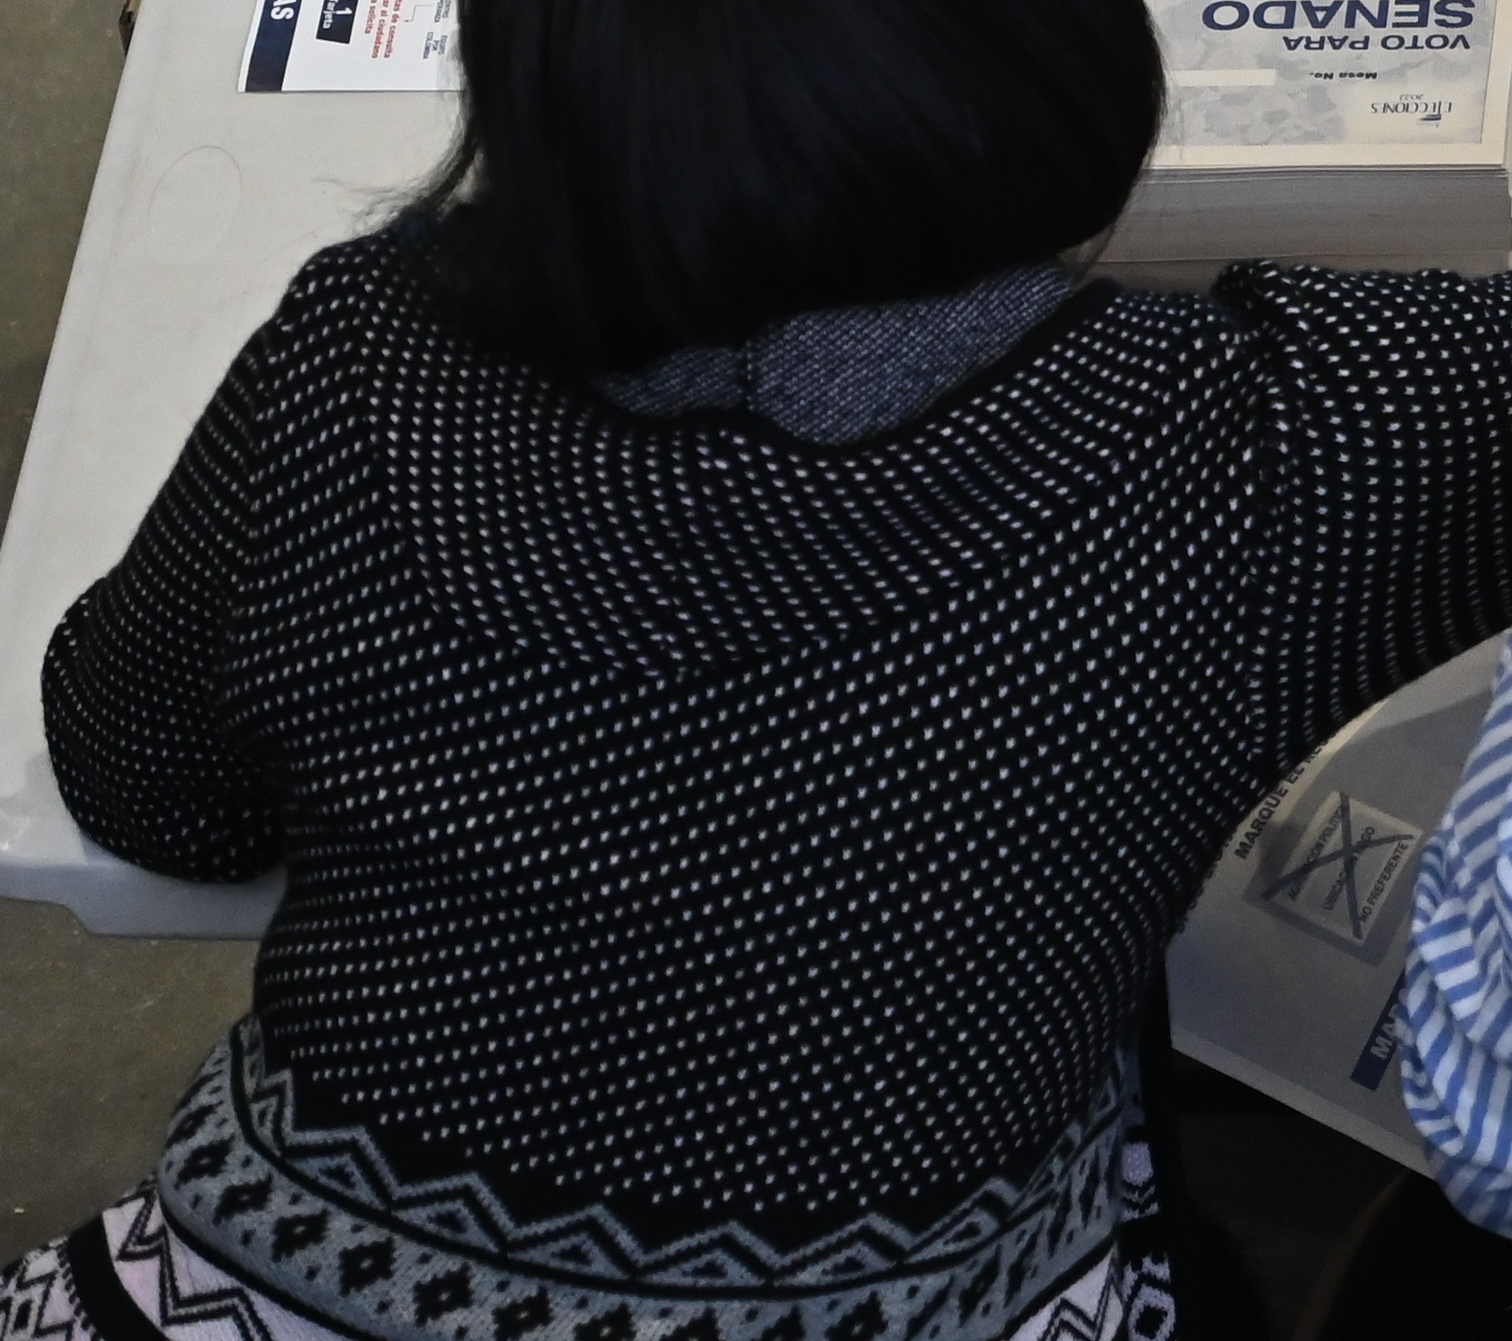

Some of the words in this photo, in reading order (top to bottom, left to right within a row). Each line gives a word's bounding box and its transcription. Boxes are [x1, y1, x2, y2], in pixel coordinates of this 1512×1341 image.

[336, 6, 352, 16] 1
[1203, 0, 1476, 30] SENADO
[1283, 36, 1370, 51] PARA
[1381, 35, 1470, 50] VOTO
[1235, 787, 1288, 859] MARQUE
